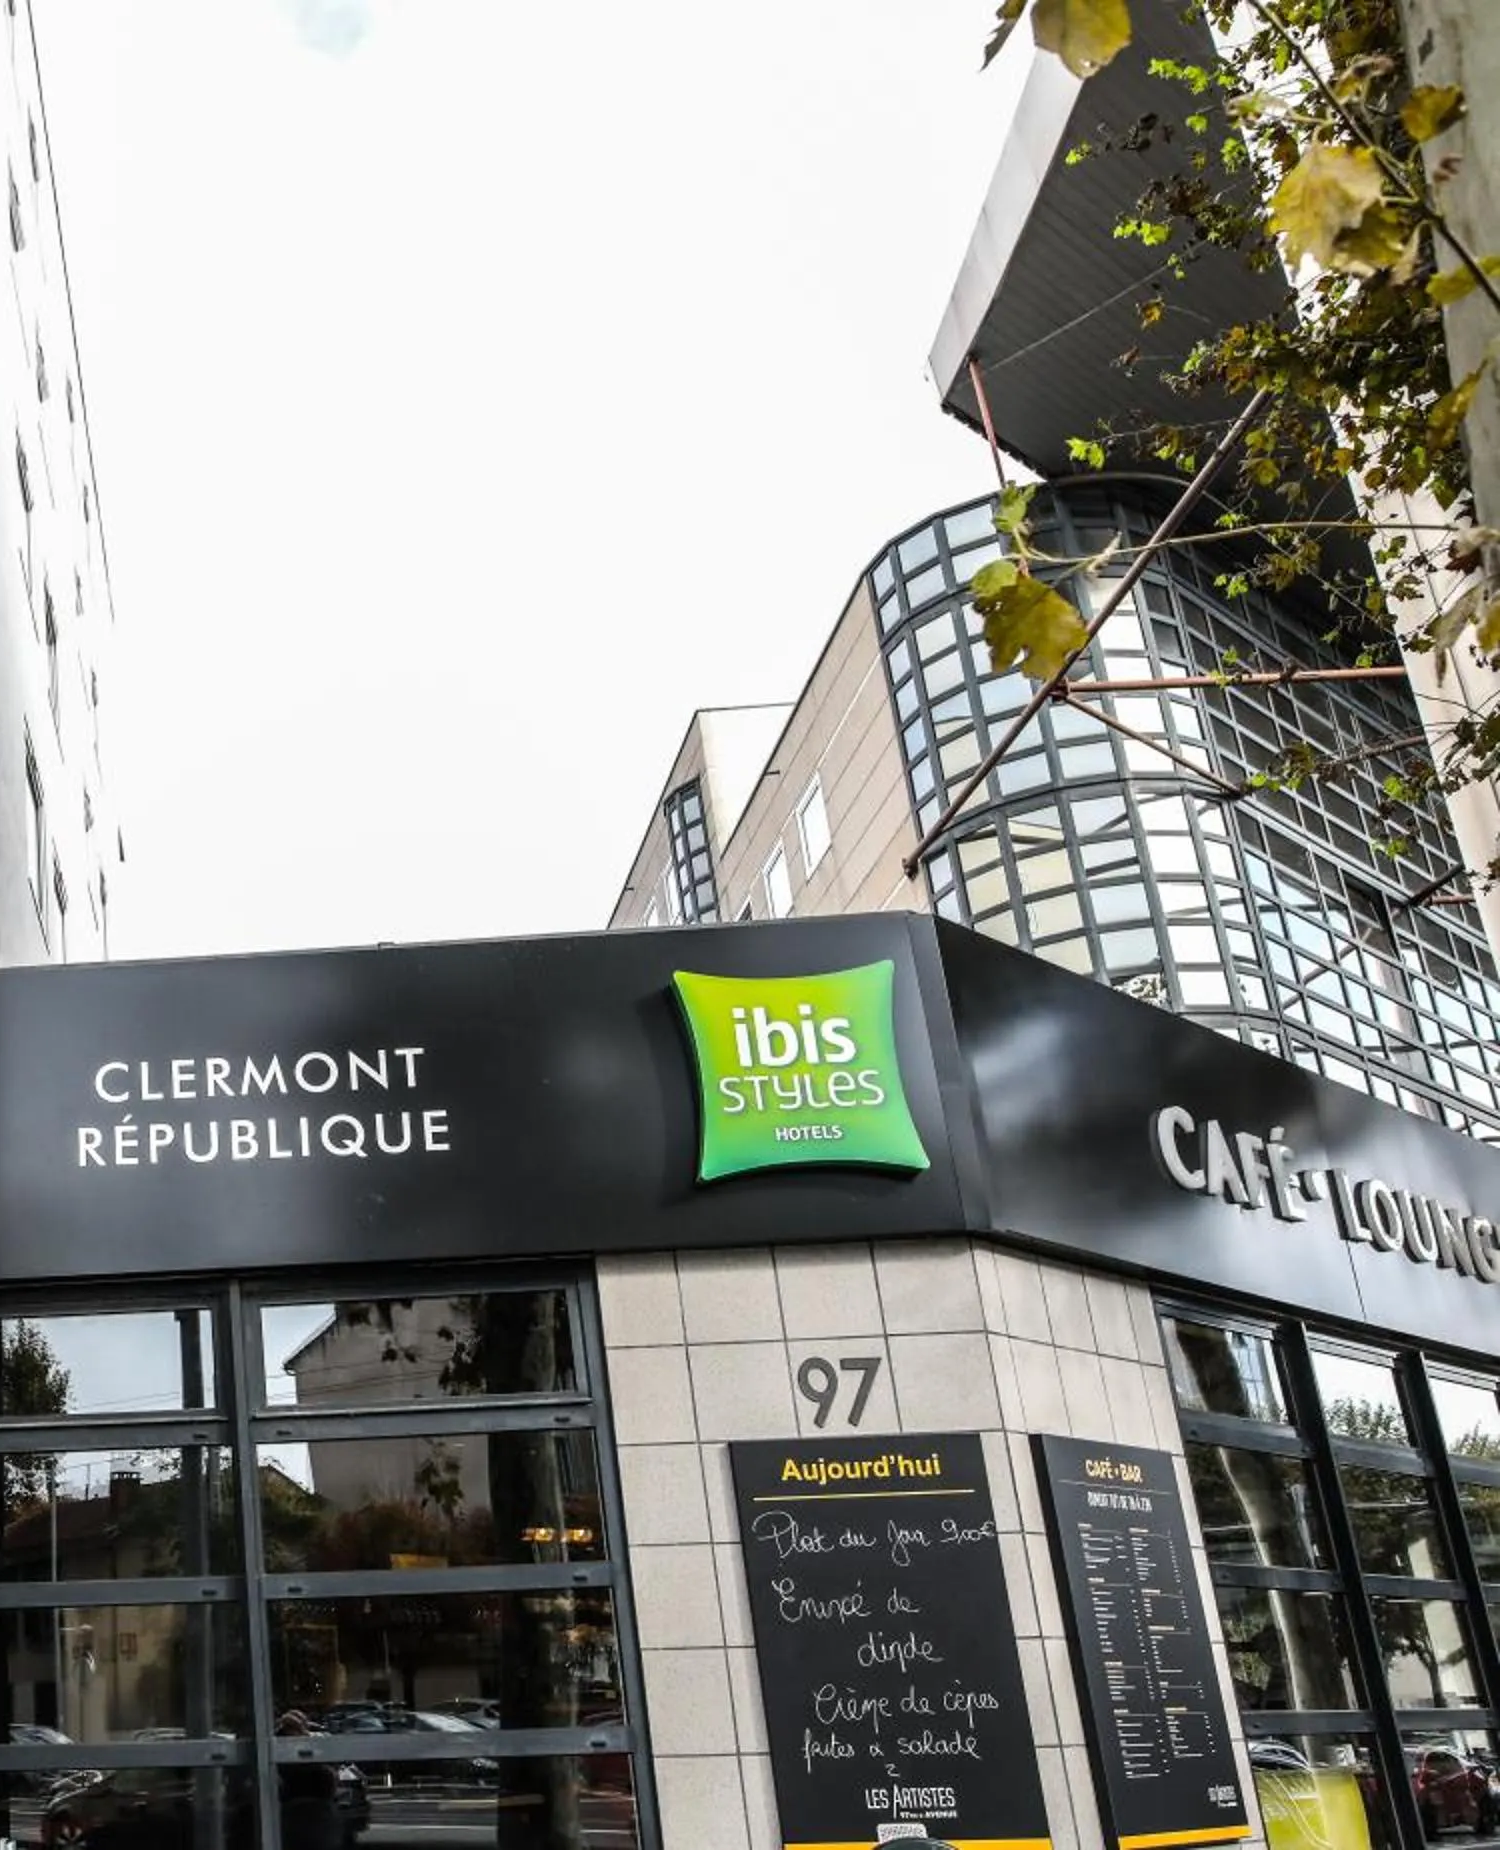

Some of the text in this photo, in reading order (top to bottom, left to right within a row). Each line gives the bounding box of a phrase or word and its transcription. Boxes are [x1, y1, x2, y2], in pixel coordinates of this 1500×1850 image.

[731, 1003, 857, 1068] ibis
[94, 1047, 424, 1103] CLERMONT
[77, 1110, 451, 1168] RÉPUBLIQUE
[774, 1125, 843, 1141] HOTELS
[1150, 1104, 1500, 1284] CAFÉ LOUNG
[797, 1356, 882, 1428] 97
[781, 1453, 942, 1486] Aujourd'hui
[751, 1510, 836, 1559] Plat
[839, 1526, 878, 1548] du
[887, 1587, 920, 1615] de
[857, 1630, 946, 1673] dinde
[899, 1684, 937, 1716] de
[897, 1729, 983, 1760] salade
[864, 1783, 956, 1819] LES ARTISTES
